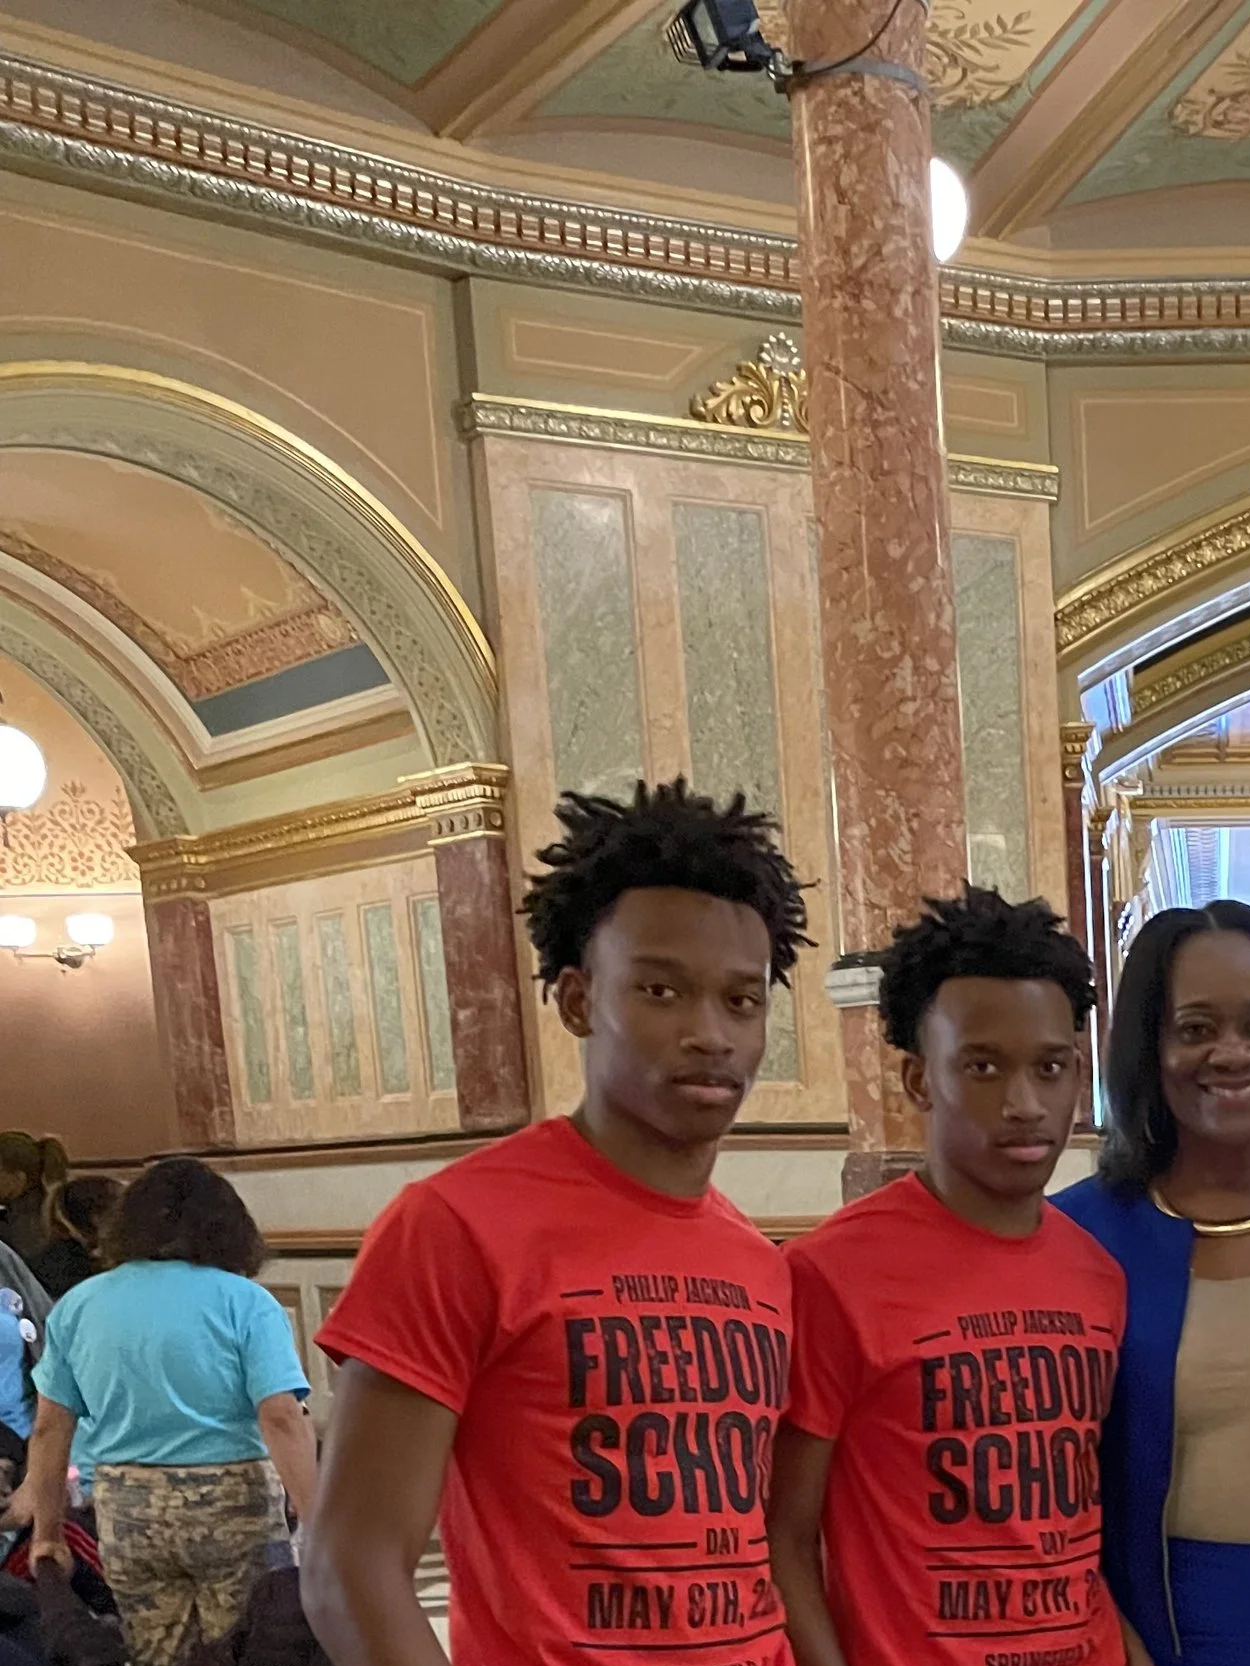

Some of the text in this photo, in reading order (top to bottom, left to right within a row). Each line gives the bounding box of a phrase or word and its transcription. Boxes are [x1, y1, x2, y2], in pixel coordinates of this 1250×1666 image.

[611, 1274, 752, 1312] PHILLIP JACKSON
[957, 1309, 1086, 1340] PHILLIP JACKSON
[570, 1411, 774, 1518] SCHOO
[926, 1426, 1102, 1525] SCHOO
[705, 1528, 740, 1556] DAY
[587, 1582, 676, 1630] MAY
[939, 1578, 1013, 1621] MAY
